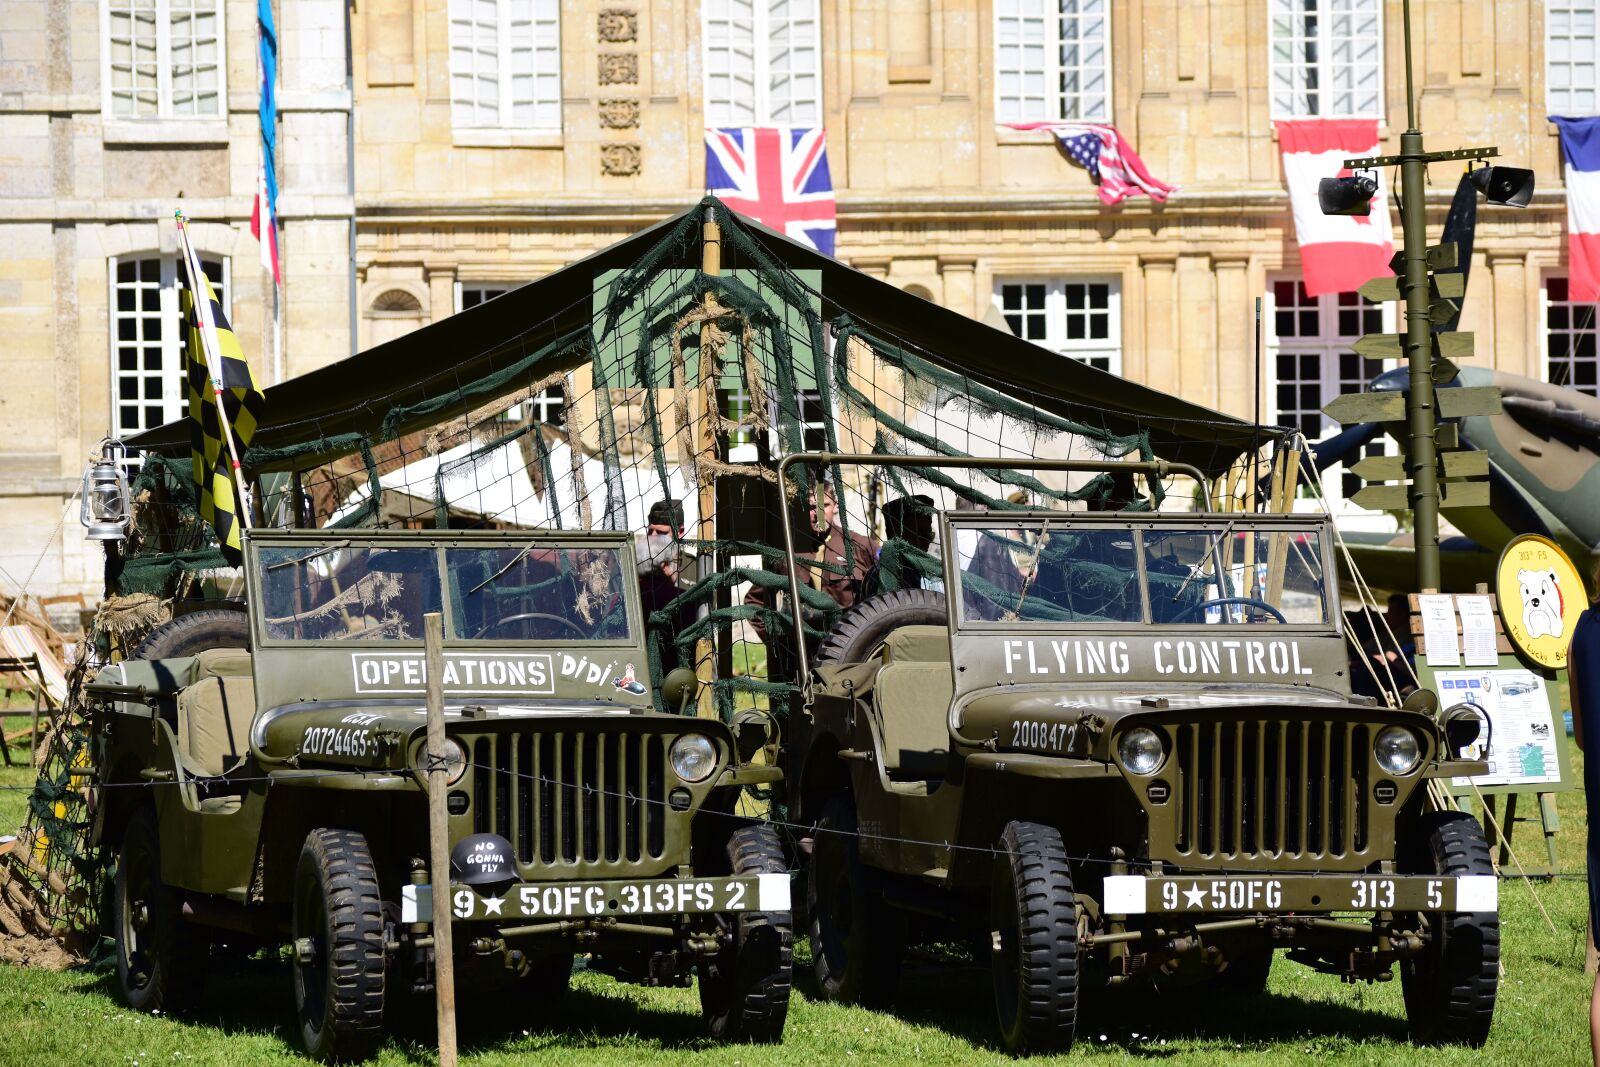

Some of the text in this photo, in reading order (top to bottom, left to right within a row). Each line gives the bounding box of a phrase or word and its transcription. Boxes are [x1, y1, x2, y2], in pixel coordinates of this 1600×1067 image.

[1003, 640, 1313, 675] FLYING CONTROL
[1526, 644, 1548, 664] Lucky
[361, 660, 546, 686] OPEATIONS
[475, 842, 496, 852] NO
[466, 854, 505, 864] GONNA
[481, 863, 498, 873] FLY
[453, 881, 746, 919] 9 50FG 313FS 2
[1163, 880, 1443, 910] 9 50FG 313 5
